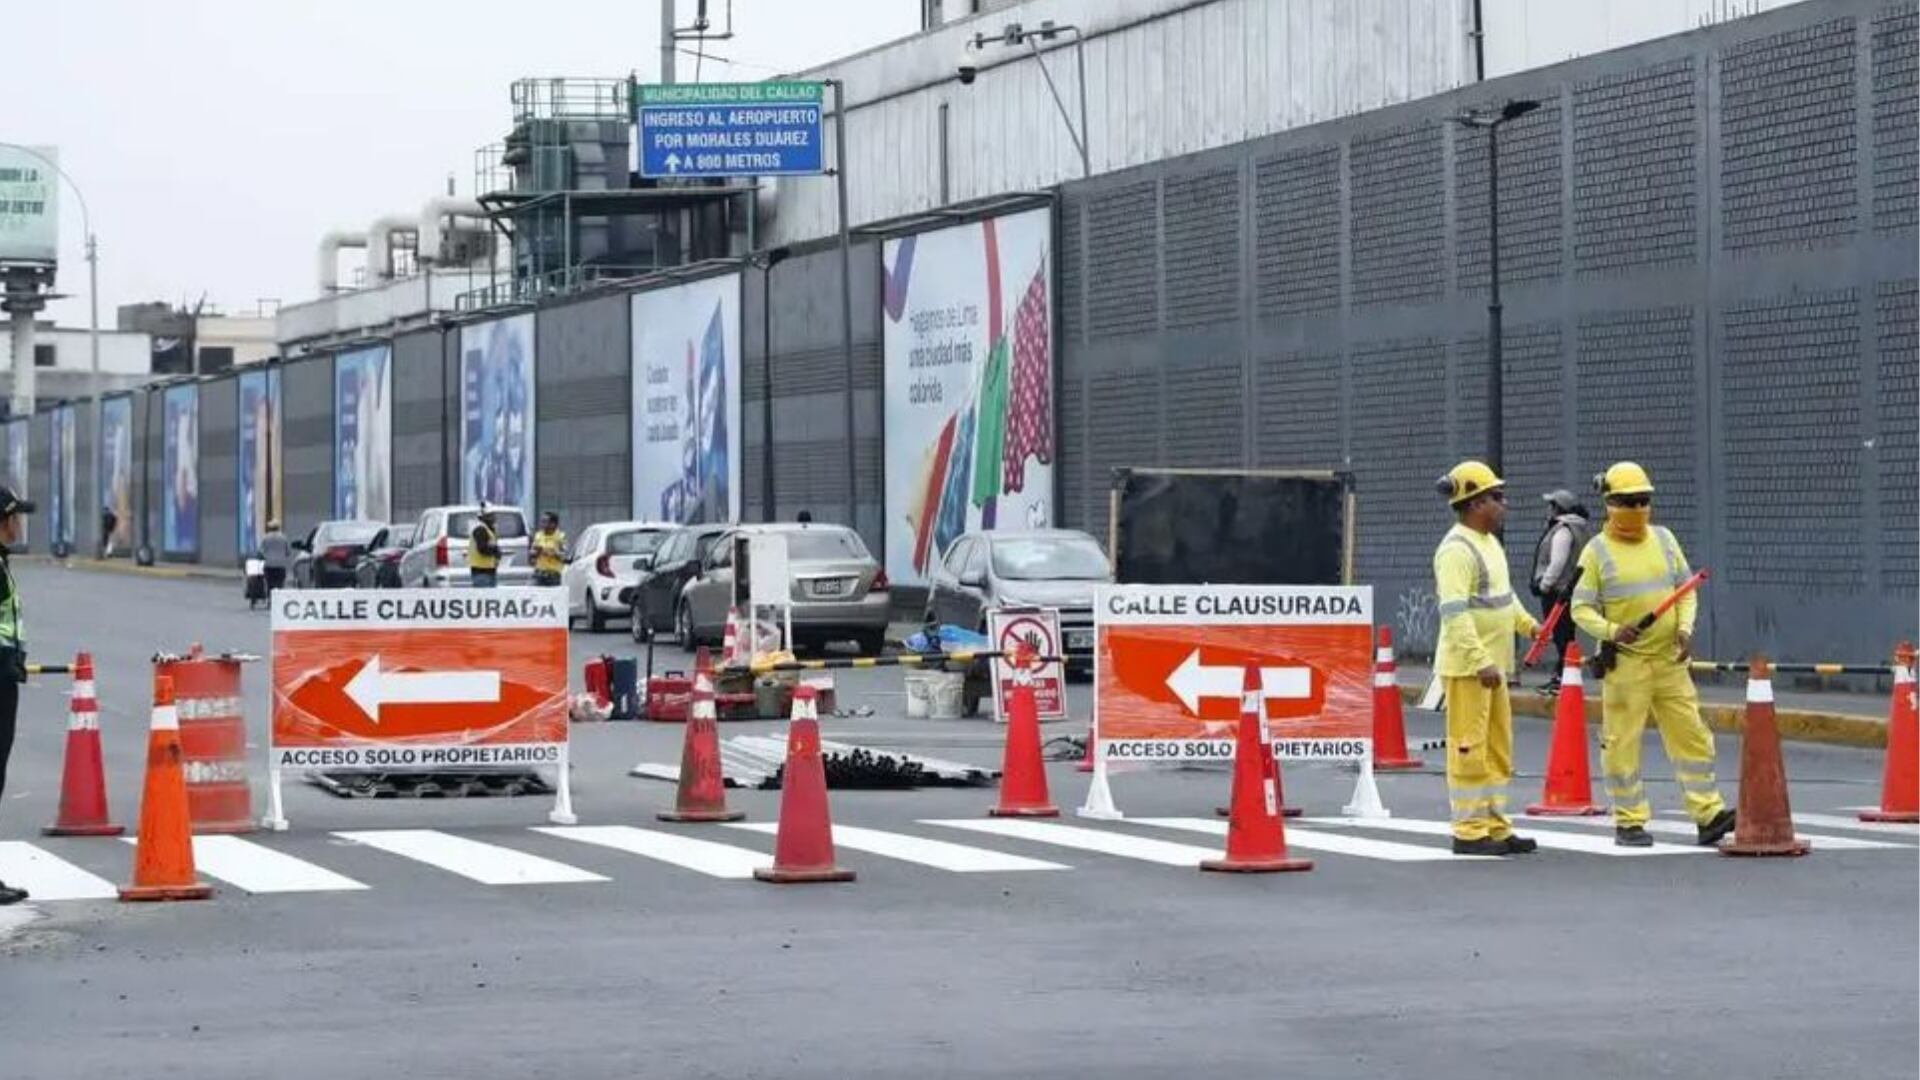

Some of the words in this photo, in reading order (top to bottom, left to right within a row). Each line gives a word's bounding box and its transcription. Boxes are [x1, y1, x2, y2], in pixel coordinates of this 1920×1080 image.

[644, 87, 736, 101] MUNICIPALIDAD
[740, 87, 762, 99] DEL
[766, 85, 816, 99] CALLAO
[645, 112, 704, 127] INGRESO
[708, 111, 725, 126] AL
[728, 109, 816, 125] AEROPUERTO
[655, 133, 683, 149] POR
[687, 131, 751, 147] MORALES
[684, 155, 694, 169] A
[726, 153, 781, 168] METROS
[283, 599, 368, 620] CALLE
[377, 598, 557, 619] CLAUSURADA
[1108, 595, 1187, 615] CALLE
[1195, 595, 1362, 615] CLAUSURADA
[281, 750, 359, 765] ACCESO
[364, 749, 416, 764] SOLO
[421, 747, 559, 763] PROPIETARIOS
[1107, 742, 1179, 757] ACCESO
[1184, 742, 1233, 757] SOLO
